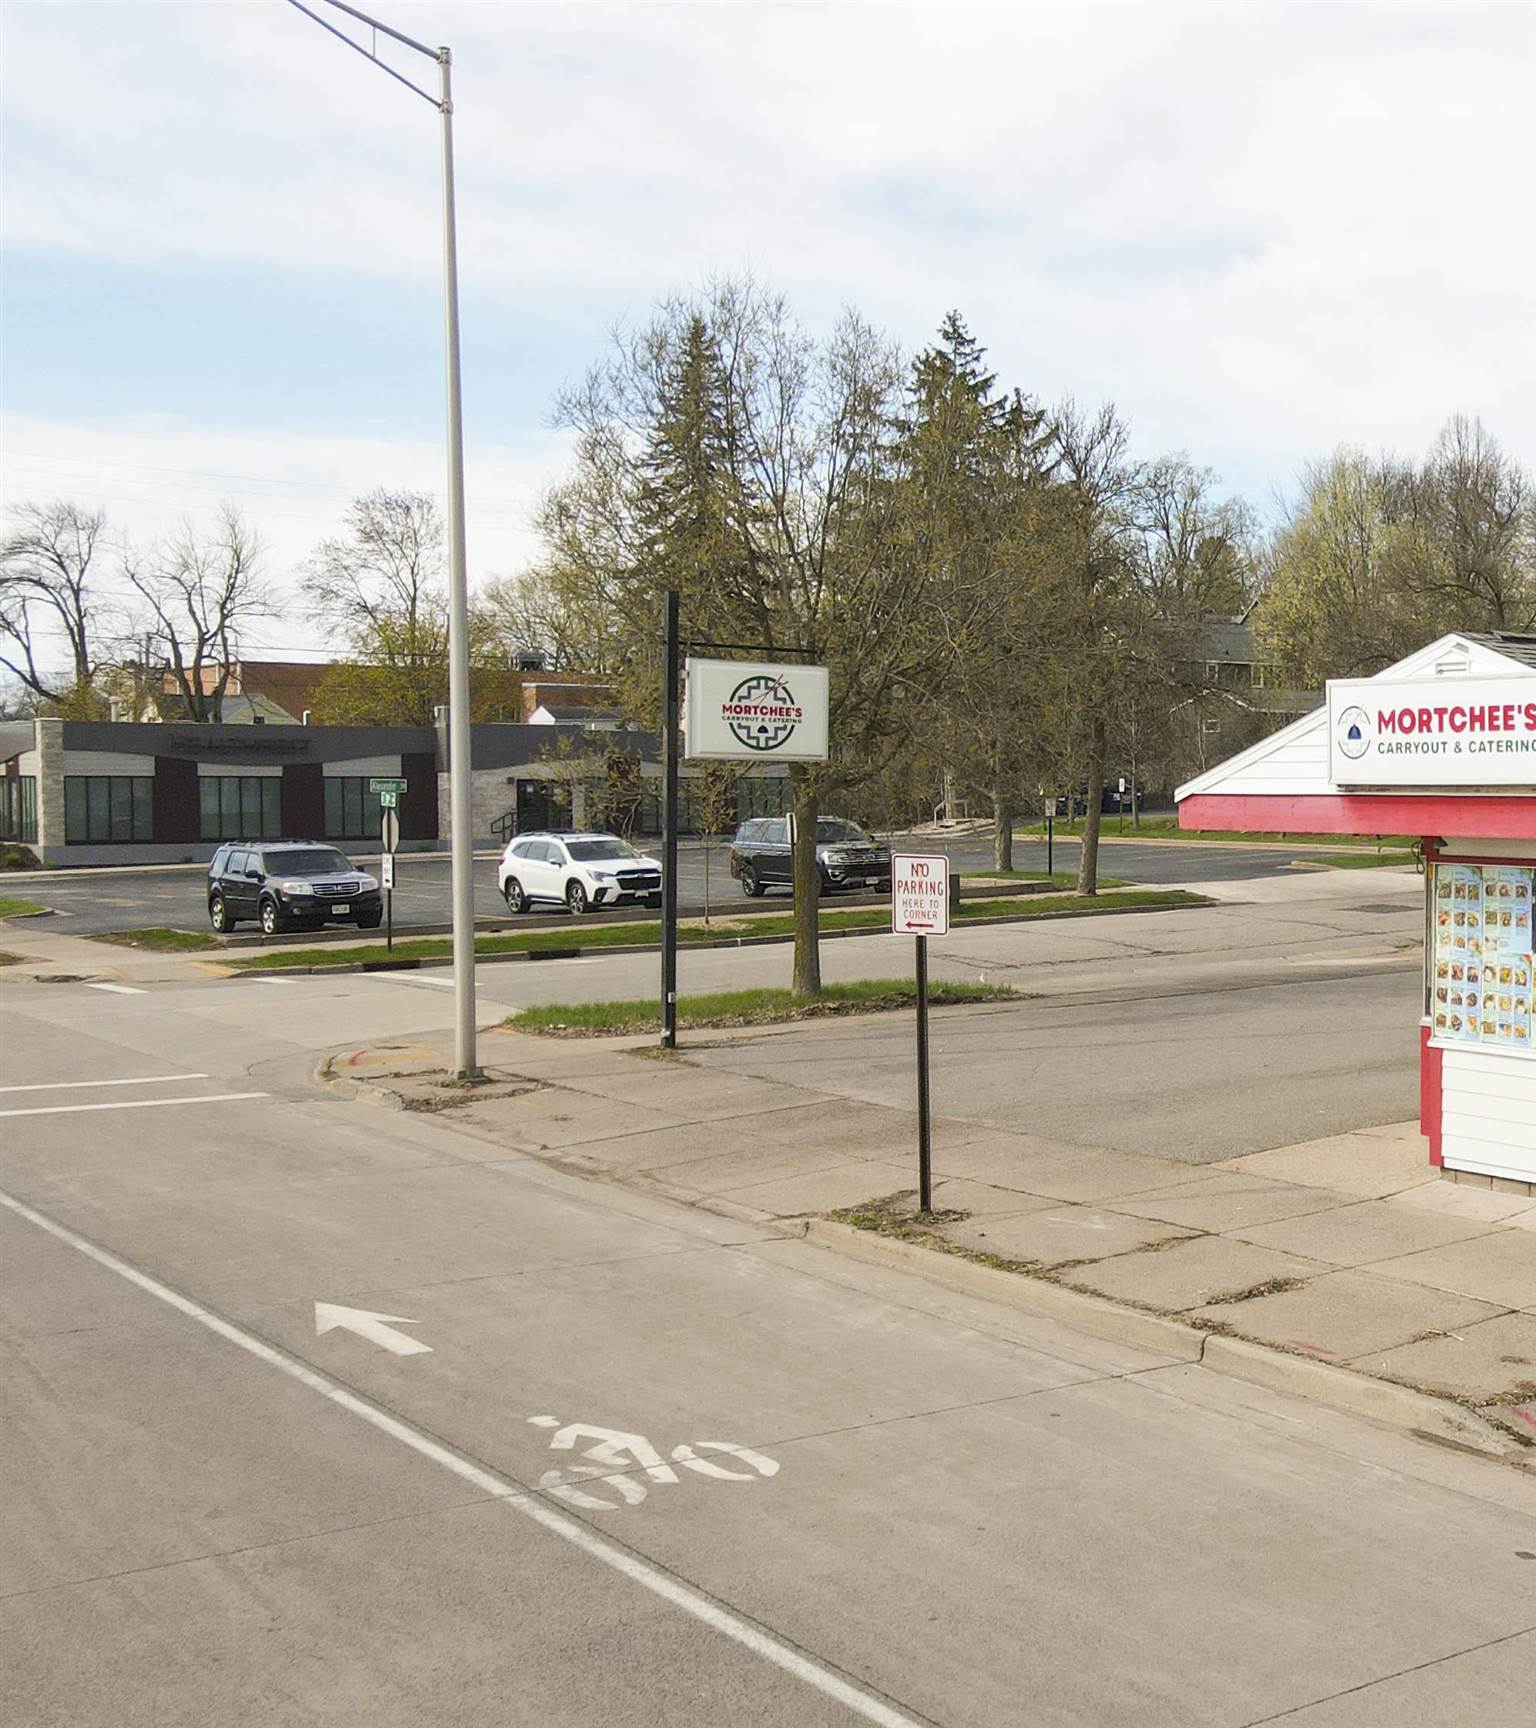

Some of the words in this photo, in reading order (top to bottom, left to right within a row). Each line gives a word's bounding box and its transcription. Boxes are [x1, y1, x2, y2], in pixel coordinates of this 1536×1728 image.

[722, 704, 802, 717] MORTCHEE'S
[1377, 741, 1448, 754] CARRYOUT
[1454, 741, 1462, 753] &
[911, 863, 929, 877] NO
[898, 880, 944, 896] PARKING
[903, 899, 925, 909] HERE
[930, 900, 939, 909] TO
[904, 909, 938, 919] CORNER
